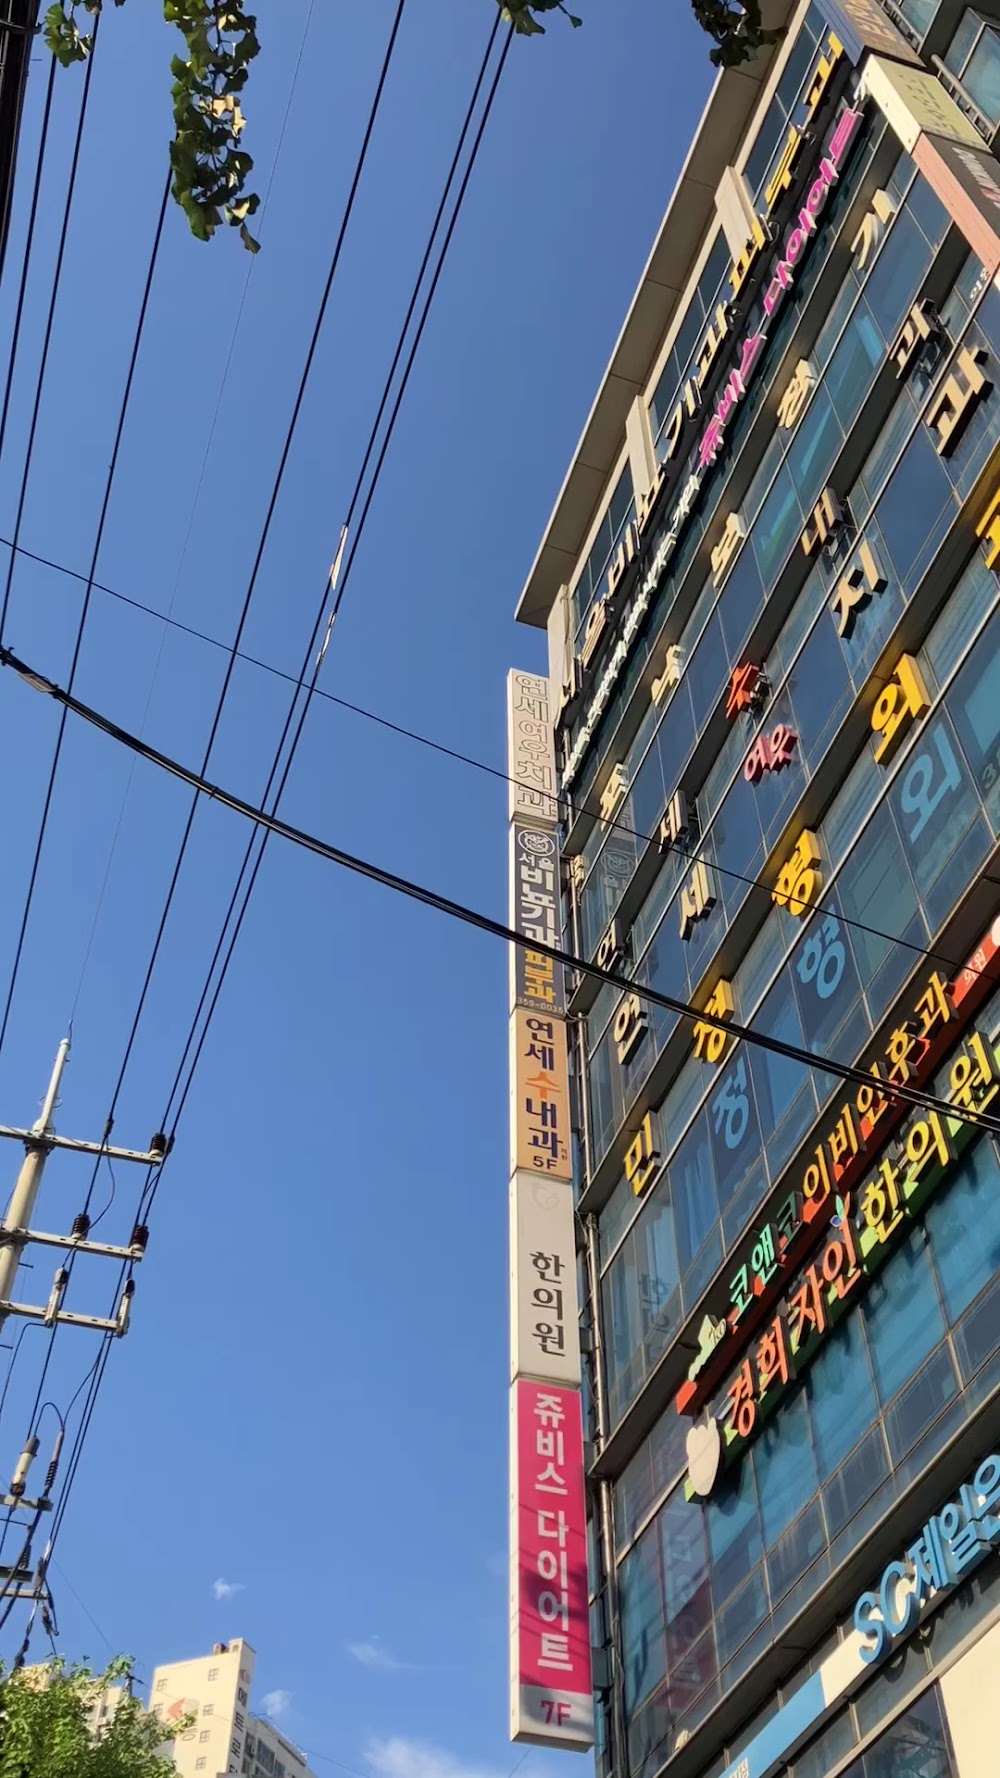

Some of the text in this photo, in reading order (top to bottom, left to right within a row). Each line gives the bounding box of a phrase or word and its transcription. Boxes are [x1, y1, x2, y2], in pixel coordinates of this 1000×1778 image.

[699, 333, 767, 467] 쥬비스
[764, 107, 863, 316] 다이어트
[515, 674, 556, 817] 연세여우치과
[518, 853, 554, 872] 서울
[524, 1018, 564, 1160] 연세수내과
[533, 1154, 558, 1171] 5F
[530, 1251, 566, 1357] 한의원
[533, 1392, 568, 1496] 쥬비스
[537, 1510, 573, 1672] 다이어트
[540, 1699, 571, 1727] 7F
